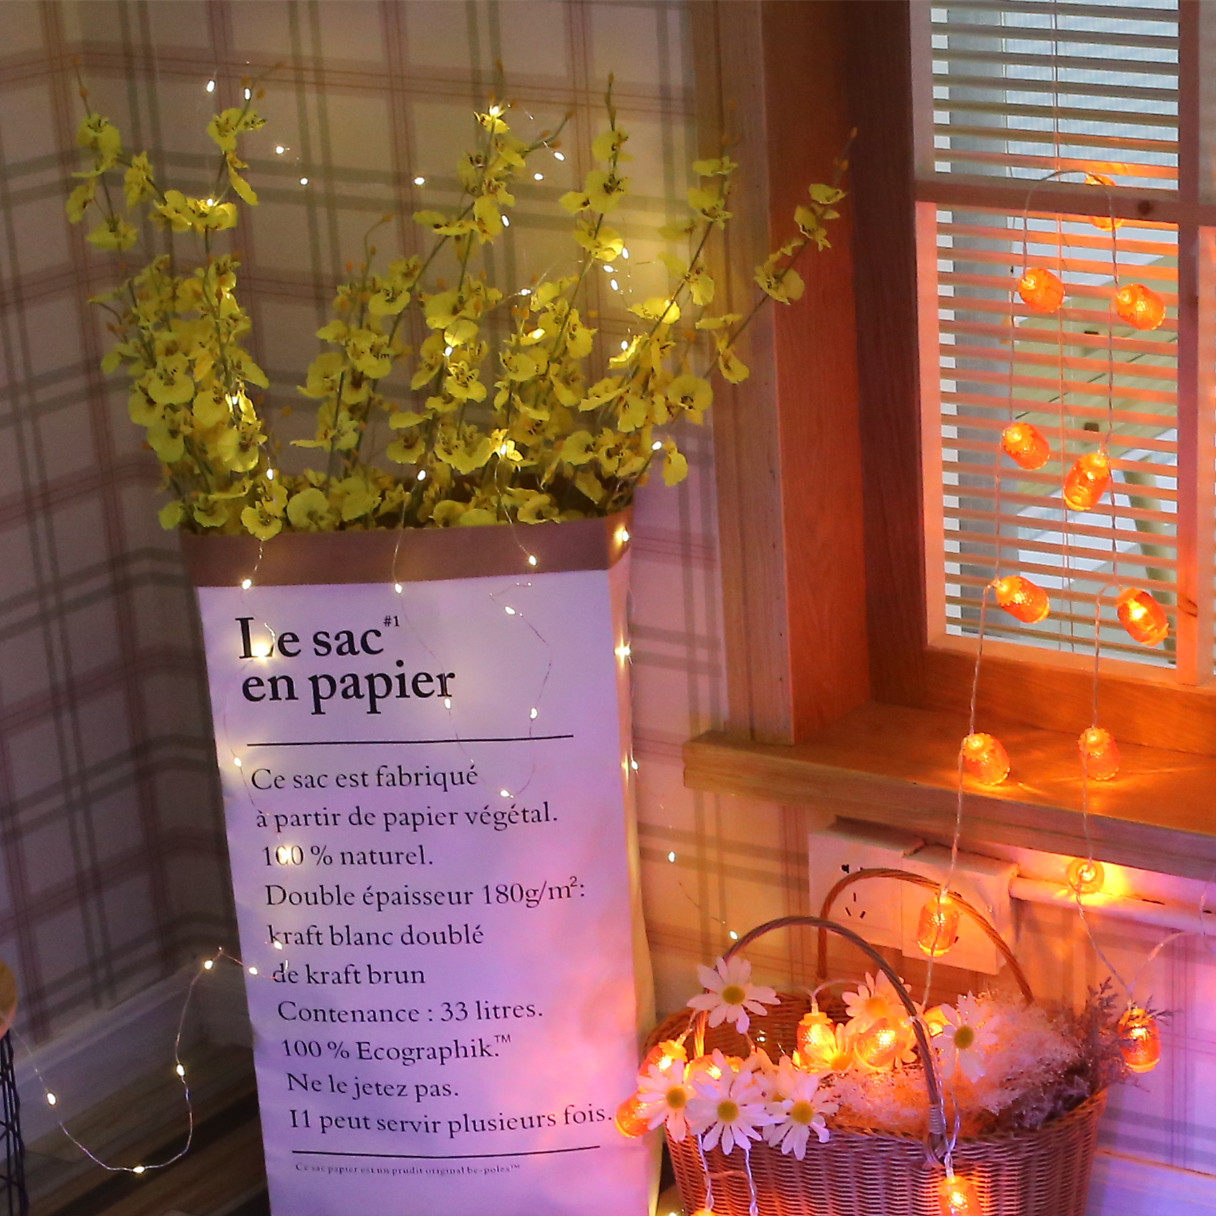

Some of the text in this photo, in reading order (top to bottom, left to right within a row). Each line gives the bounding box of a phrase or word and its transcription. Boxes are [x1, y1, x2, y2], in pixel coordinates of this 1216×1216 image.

[234, 616, 302, 660] Le
[241, 659, 456, 716] en papier
[250, 764, 479, 795] Ce sac est fabriqué
[256, 801, 558, 834] à partir de papier végétal.
[262, 845, 304, 867] 100
[339, 844, 434, 866] naturel.
[264, 883, 356, 906] Double
[362, 884, 474, 913] épaisseur
[266, 923, 485, 947] kraft blanc doublé
[272, 962, 426, 985] de kraft brun
[277, 1000, 420, 1024] Contenance
[440, 1001, 469, 1022] 33
[475, 999, 543, 1021] litres.
[281, 1038, 322, 1058] 100
[285, 1072, 459, 1104] Ne le jetez pas.
[318, 1115, 372, 1134] peut
[376, 1114, 442, 1134] servir
[446, 1112, 557, 1140] plusieurs
[563, 1103, 613, 1125] fois.
